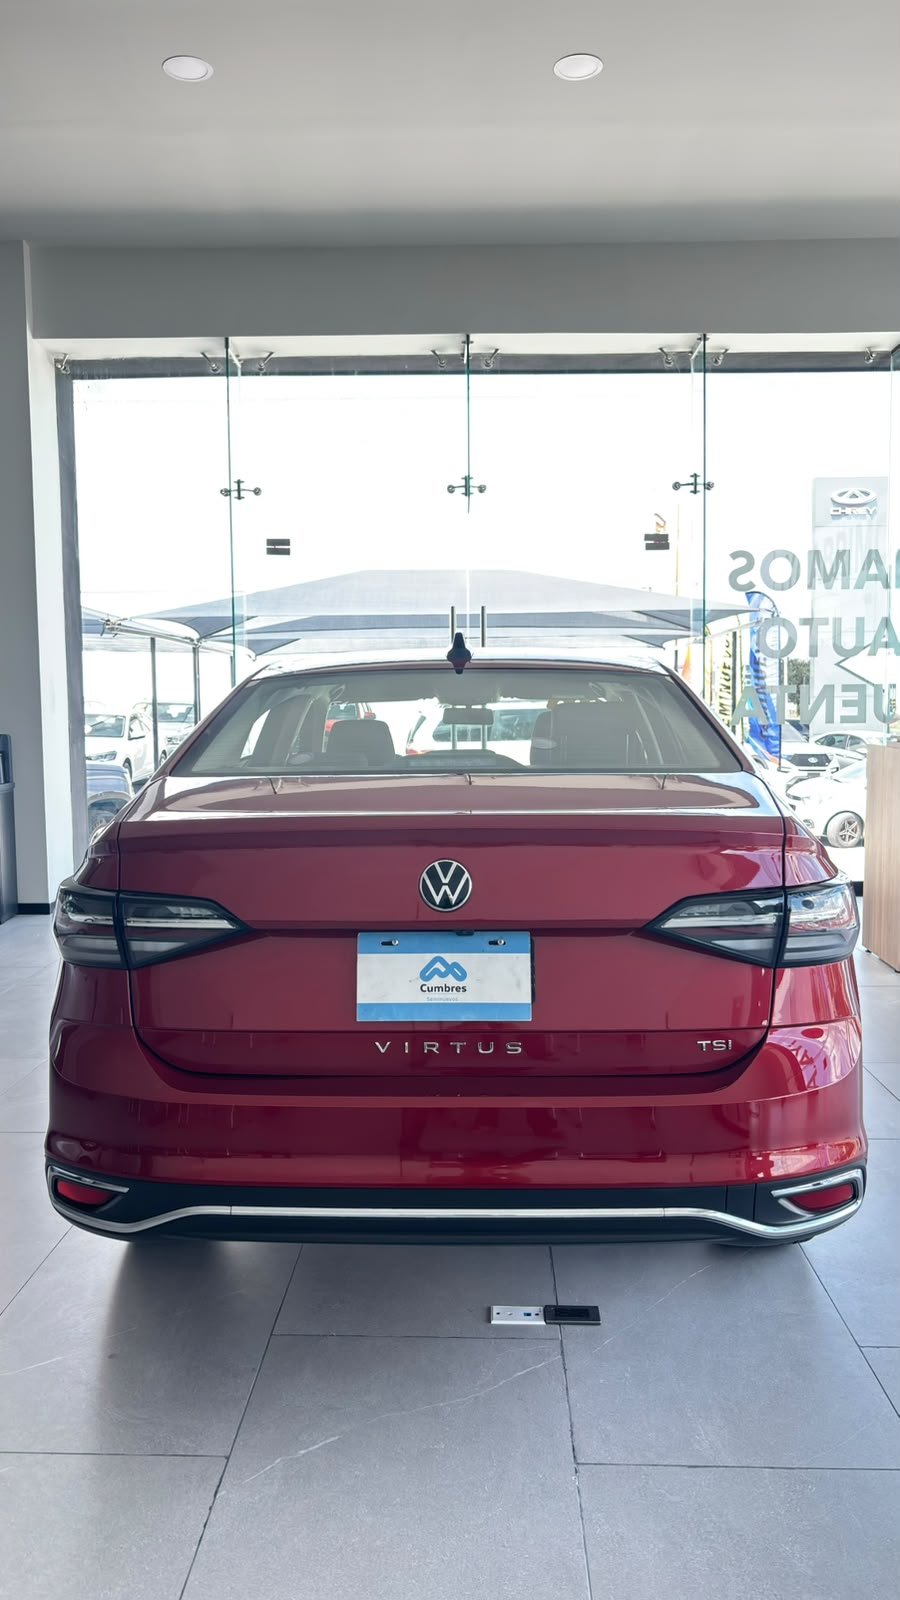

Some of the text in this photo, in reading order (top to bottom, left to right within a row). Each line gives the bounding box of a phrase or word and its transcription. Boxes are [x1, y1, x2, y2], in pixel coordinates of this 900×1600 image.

[419, 983, 467, 994] Cumbres
[375, 1041, 523, 1055] VIRTUS
[697, 1039, 733, 1052] TSI
